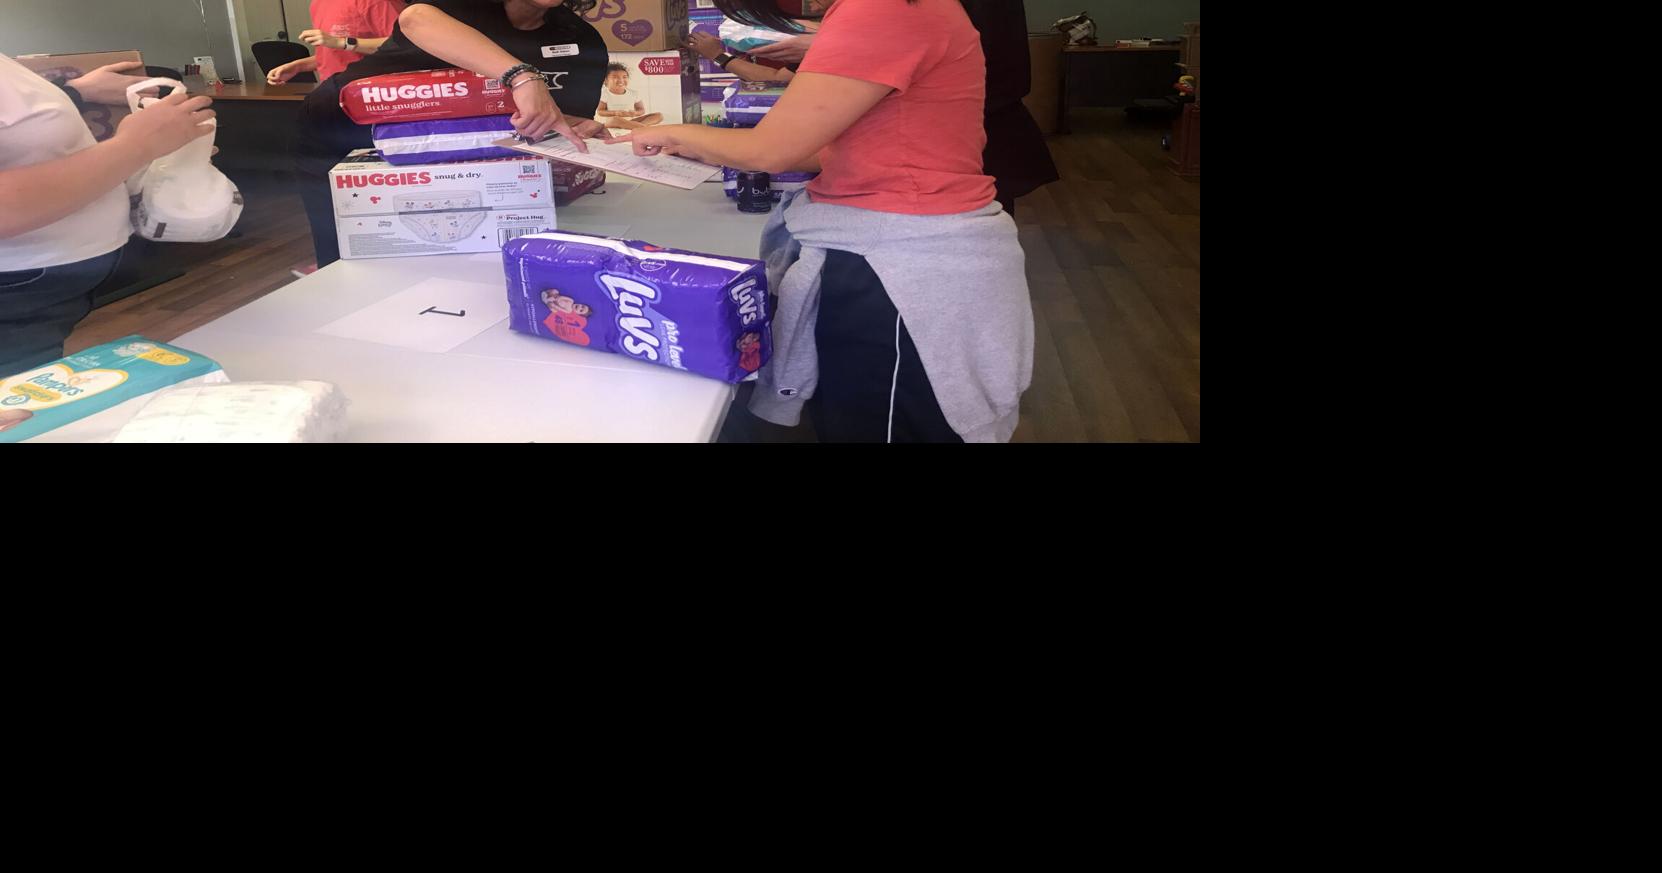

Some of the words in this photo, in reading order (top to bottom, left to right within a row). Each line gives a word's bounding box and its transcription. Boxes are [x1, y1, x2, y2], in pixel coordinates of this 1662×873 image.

[643, 58, 665, 66] SAVE
[361, 81, 469, 103] HUGGIES
[365, 103, 390, 112] little
[392, 100, 441, 111] snugglers
[336, 171, 432, 189] HUGGIES
[434, 173, 456, 181] snug
[466, 172, 482, 180] dry
[731, 279, 757, 325] Luvs
[567, 320, 581, 328] 1
[600, 273, 660, 361] Luvs
[661, 320, 680, 343] pro
[668, 344, 688, 371] level
[26, 372, 84, 396] Pampers
